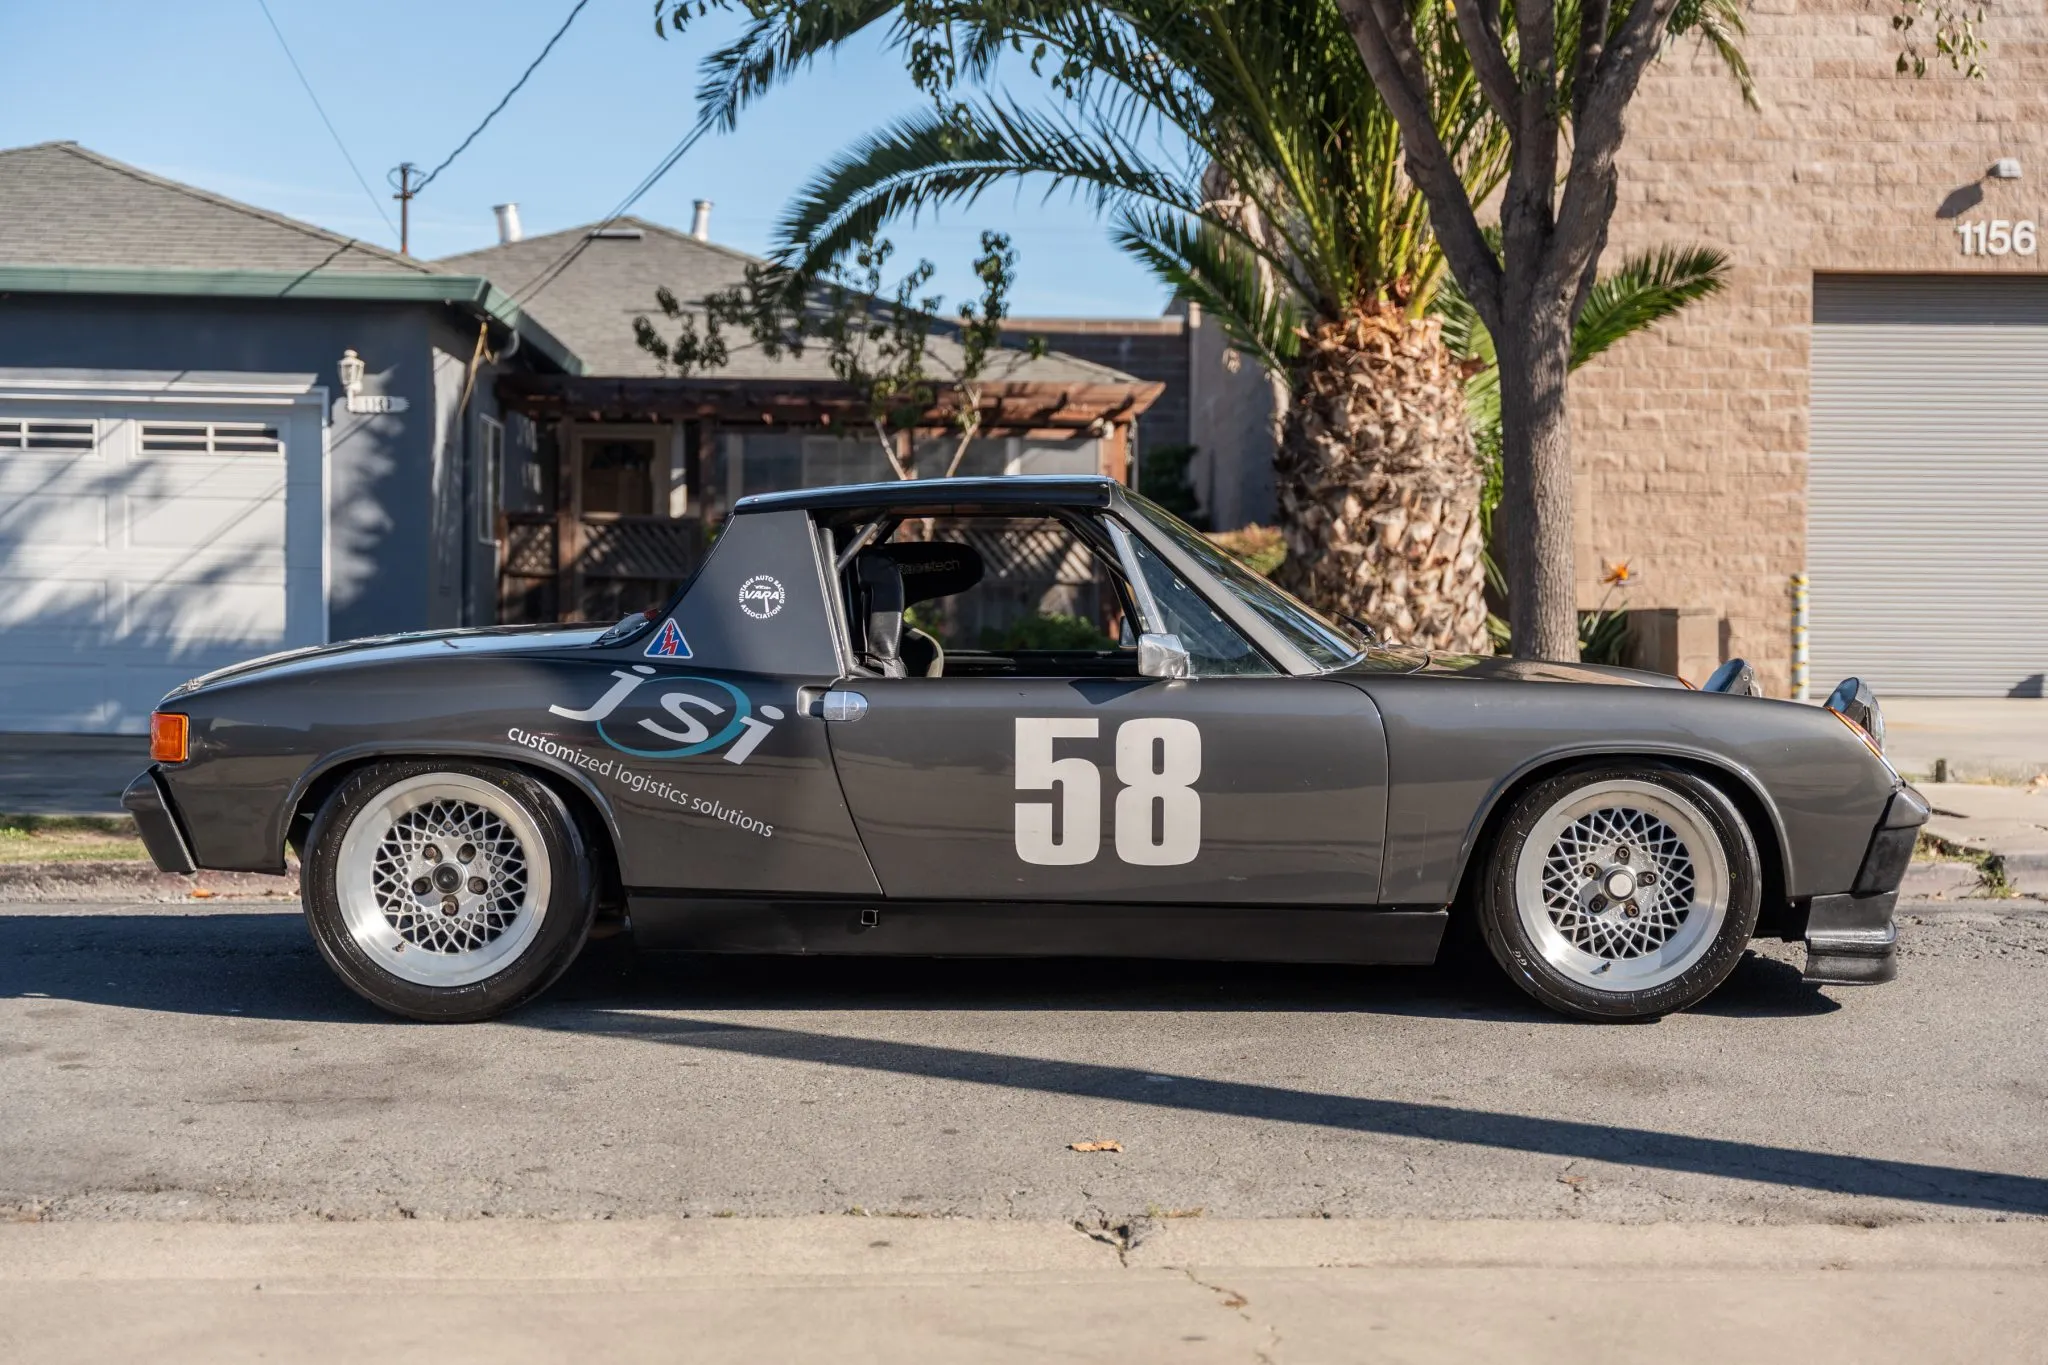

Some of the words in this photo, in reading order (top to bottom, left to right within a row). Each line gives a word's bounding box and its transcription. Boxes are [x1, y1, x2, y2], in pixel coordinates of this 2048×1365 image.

[1957, 219, 2037, 256] 1156
[738, 577, 755, 603] VINTAGE
[773, 580, 786, 604] RACING
[740, 604, 783, 619] ASSOCIATION
[548, 664, 785, 765] jsi
[507, 726, 611, 777] customized
[614, 759, 689, 806] logistics
[691, 795, 775, 838] solutions
[1014, 717, 1202, 866] 58
